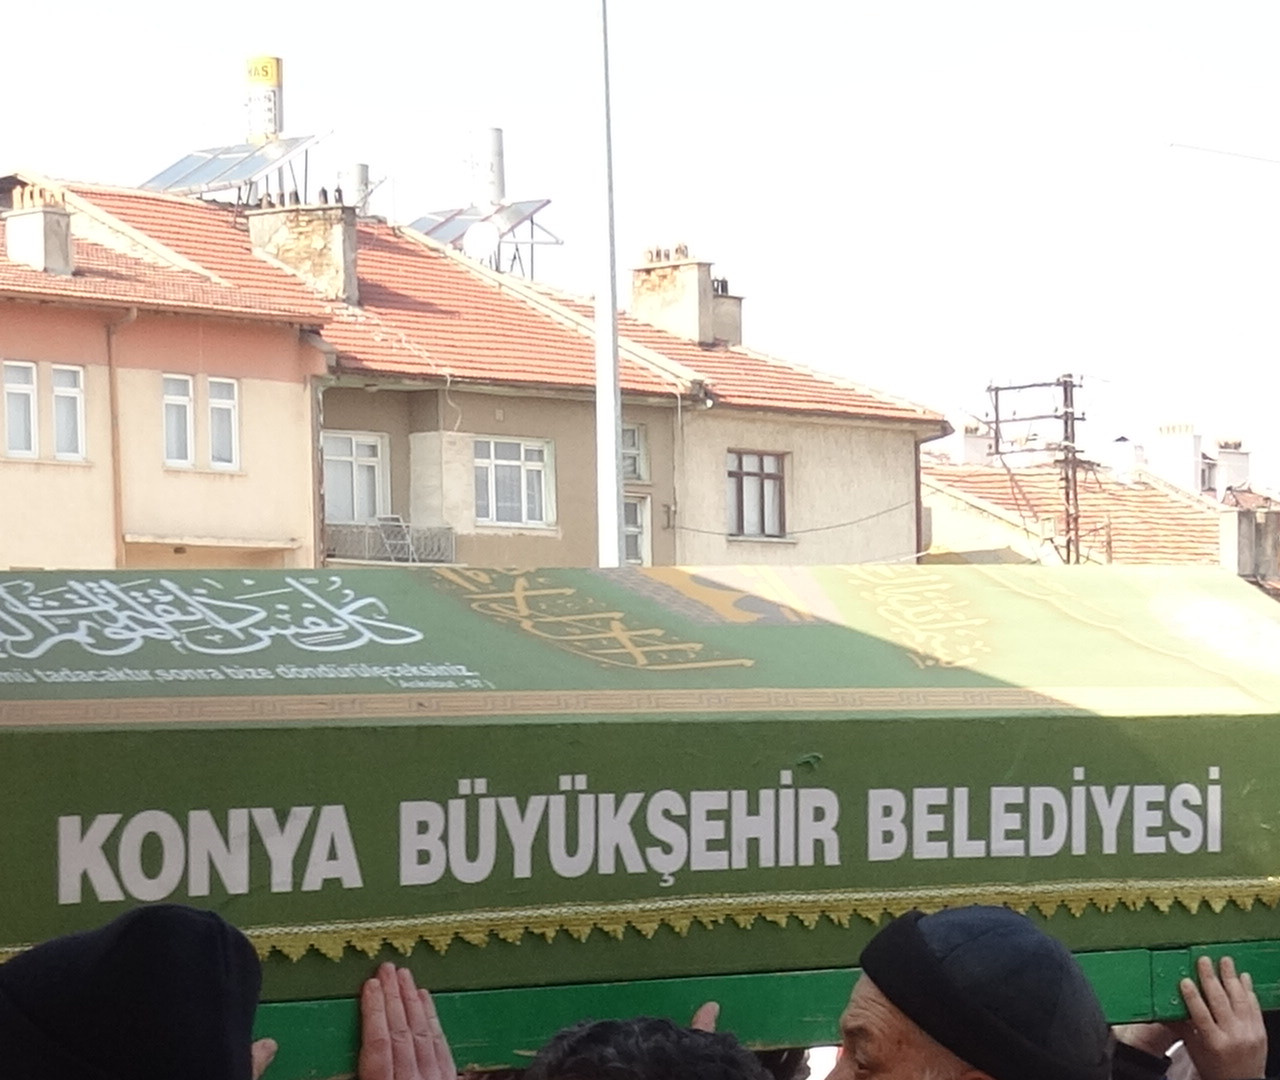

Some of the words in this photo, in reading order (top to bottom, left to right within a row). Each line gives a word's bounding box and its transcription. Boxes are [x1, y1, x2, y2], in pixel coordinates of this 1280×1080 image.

[220, 664, 275, 680] bize
[57, 804, 364, 904] KONYA
[398, 769, 841, 887] BÜYÜKŞEHİR
[866, 765, 1223, 862] BELEDİYESİ
